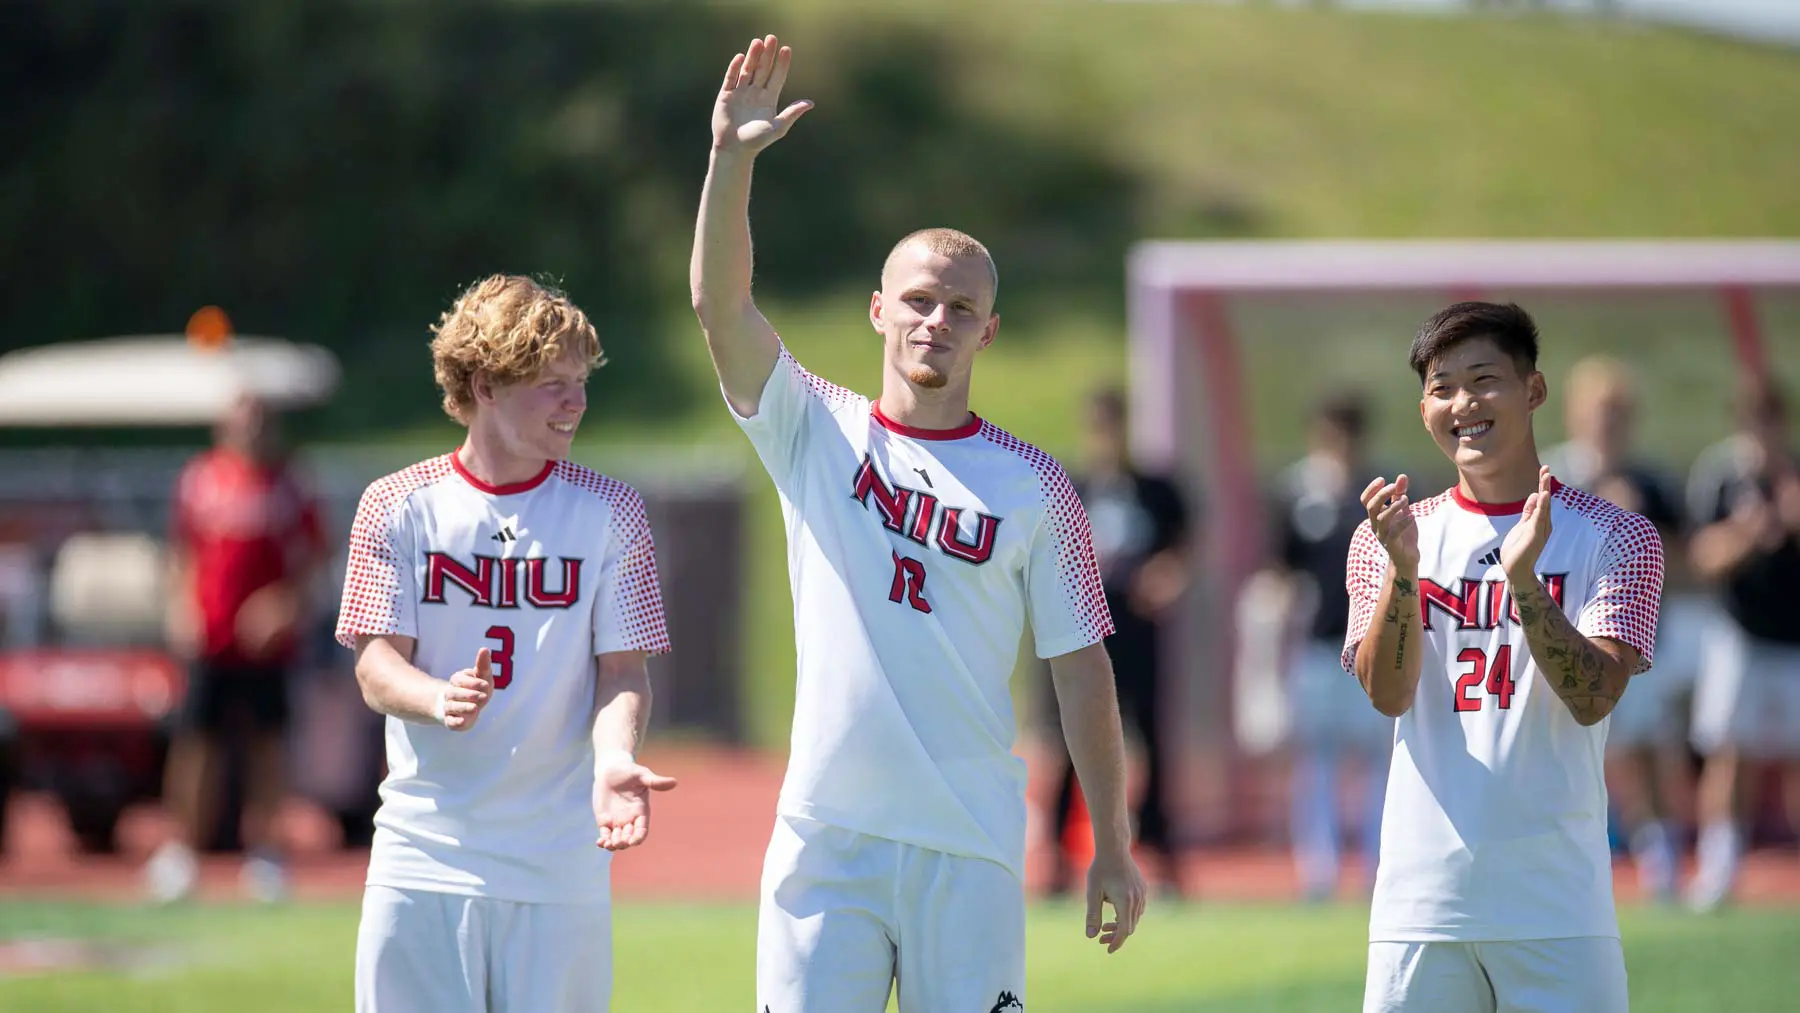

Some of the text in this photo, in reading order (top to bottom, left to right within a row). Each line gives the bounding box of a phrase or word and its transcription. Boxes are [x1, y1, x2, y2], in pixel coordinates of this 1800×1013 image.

[850, 453, 1003, 566] NIU
[420, 551, 584, 610] NIU
[485, 625, 515, 690] 3
[1454, 644, 1515, 712] 24
